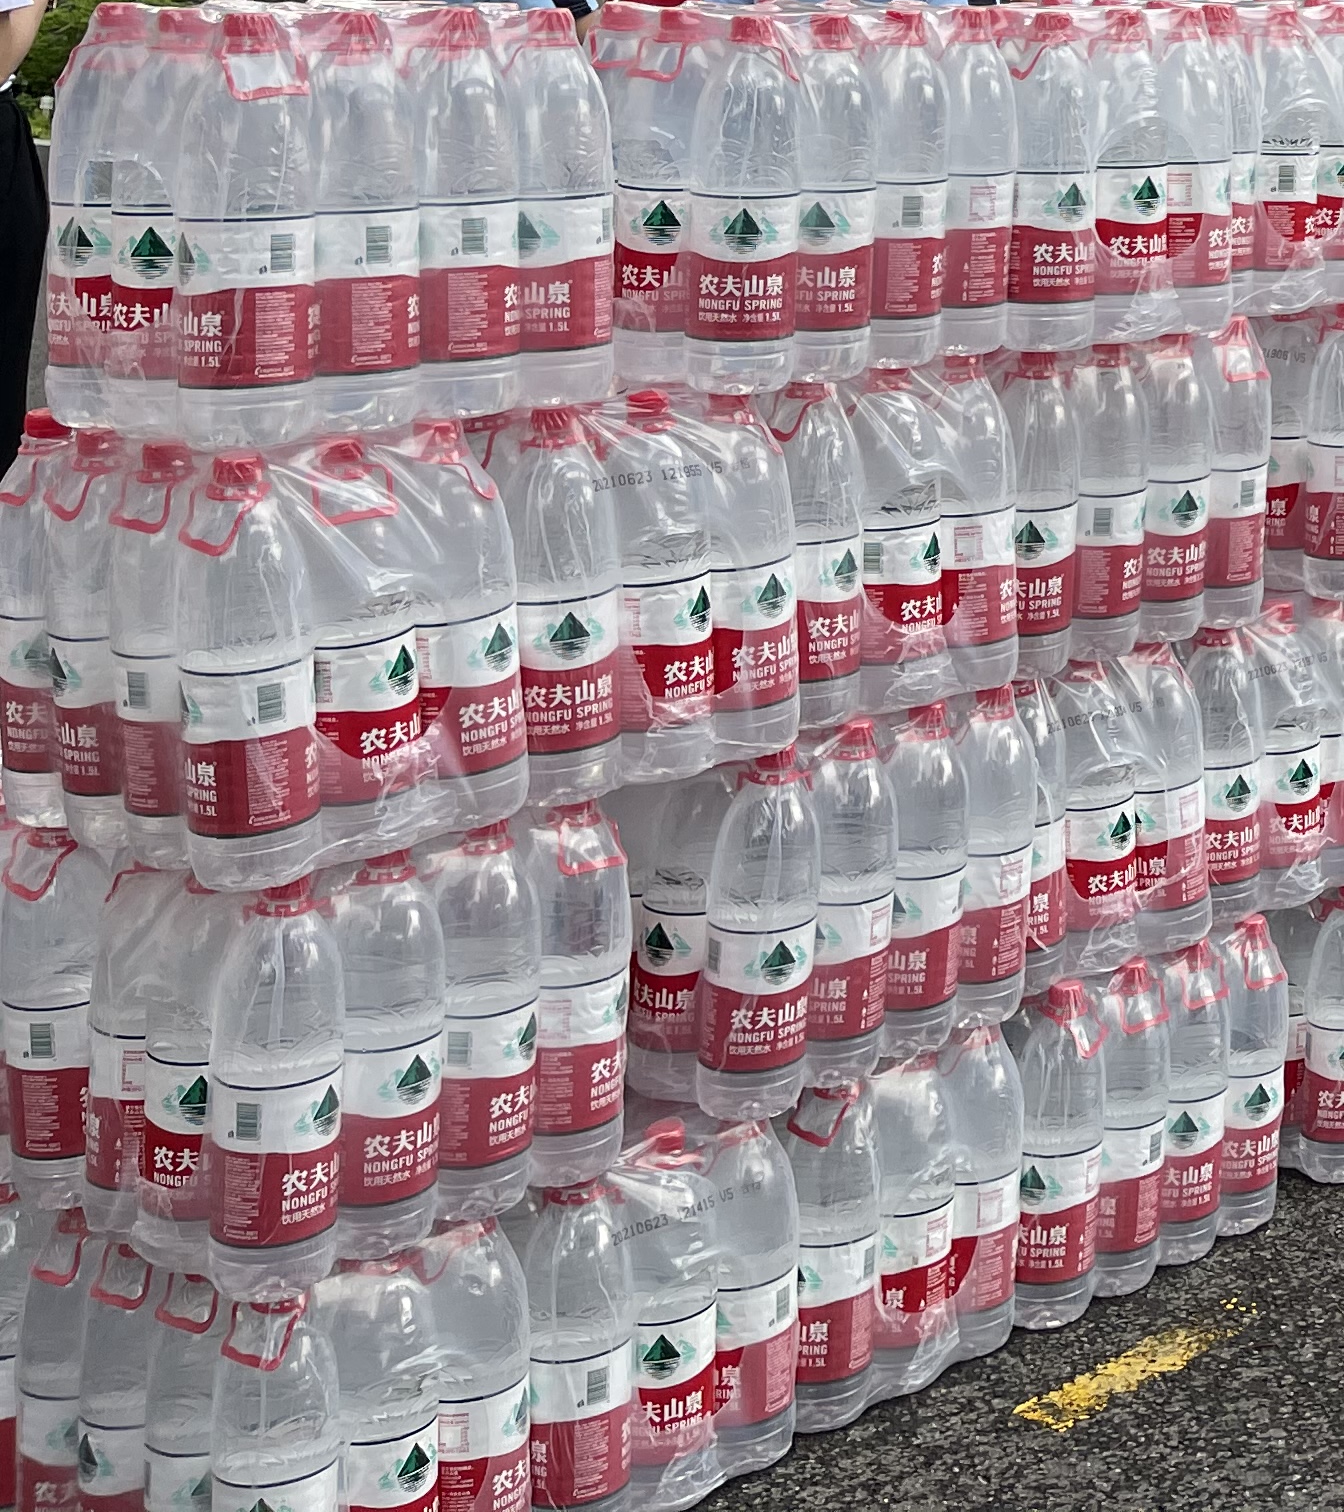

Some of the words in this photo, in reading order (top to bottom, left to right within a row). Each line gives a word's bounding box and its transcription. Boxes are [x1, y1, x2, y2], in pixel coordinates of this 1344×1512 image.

[1033, 264, 1073, 276] NONGFU
[698, 273, 783, 299] 农夫山泉
[816, 288, 856, 301] SPRING
[524, 306, 571, 320] SPRING
[698, 298, 740, 313] NONGFU
[743, 296, 783, 311] SPRING
[1028, 596, 1062, 611] SPRING
[808, 636, 849, 653] NONGFU
[524, 673, 614, 709] 农夫山泉
[664, 680, 705, 700] NONGFU
[576, 697, 614, 718] SPRING
[460, 721, 508, 744] NONGFU
[887, 971, 926, 985] SPRING
[489, 1110, 529, 1135] NONGFU
[363, 1152, 414, 1175] NONGFU
[363, 1170, 412, 1187] 饮用天然水
[281, 1186, 328, 1212] NONGFU
[281, 1204, 327, 1226] 饮用天然水
[610, 1213, 669, 1247] 20210623
[1030, 1246, 1066, 1259] SPRING
